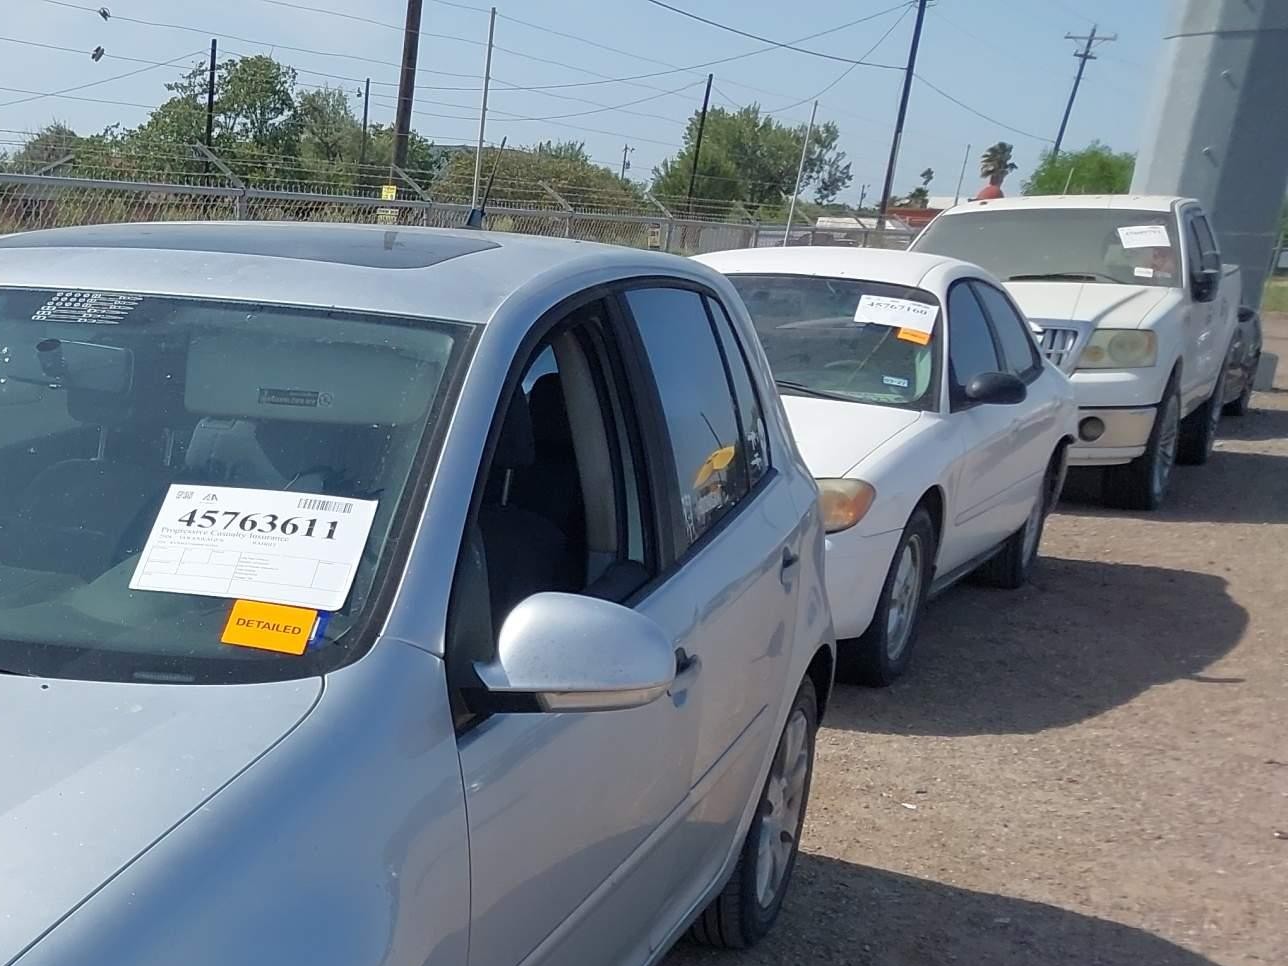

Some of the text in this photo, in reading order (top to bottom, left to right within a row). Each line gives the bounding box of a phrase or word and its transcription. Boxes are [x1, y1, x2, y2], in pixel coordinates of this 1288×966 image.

[177, 508, 339, 540] 45763611
[161, 527, 208, 536] Progressive
[210, 530, 246, 539] Casualty
[249, 533, 289, 542] Insurance
[235, 617, 302, 635] DETAILED
